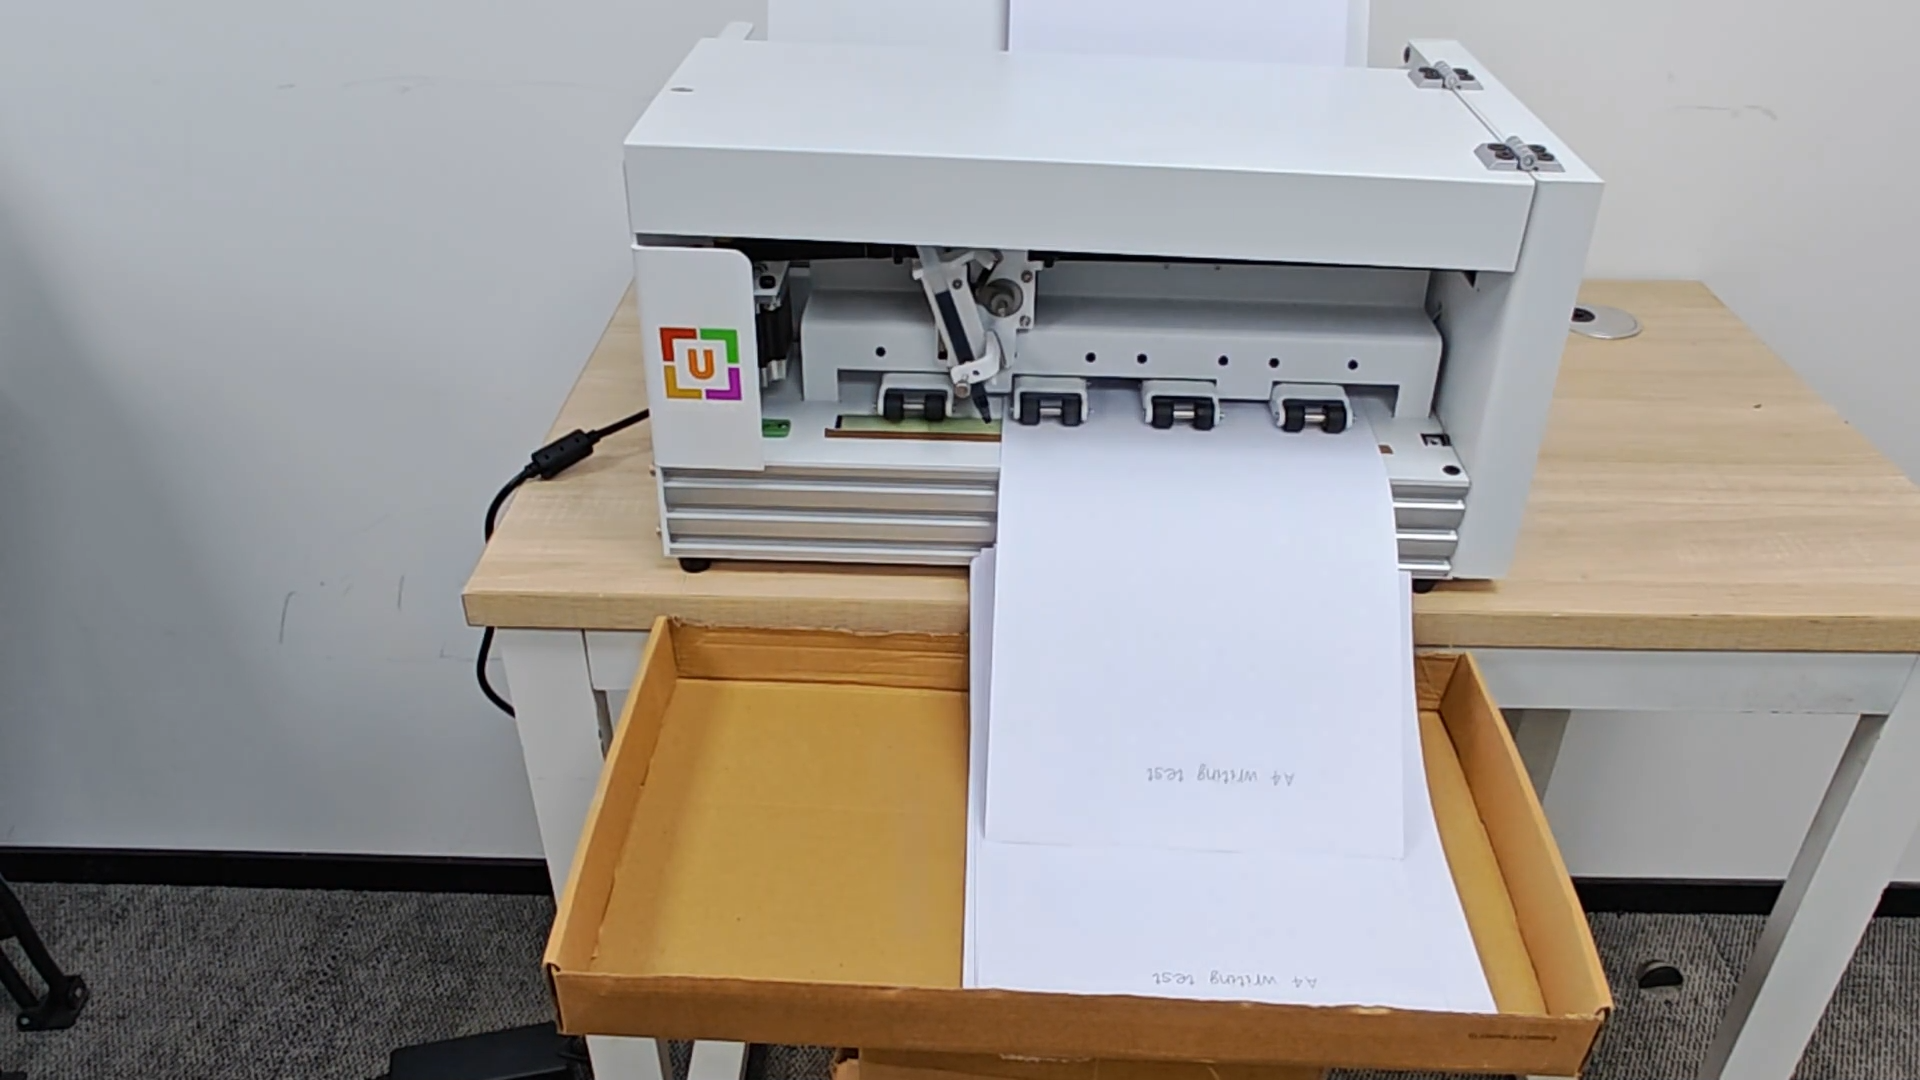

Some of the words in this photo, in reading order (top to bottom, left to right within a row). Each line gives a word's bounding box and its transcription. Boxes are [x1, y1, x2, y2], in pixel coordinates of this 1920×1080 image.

[687, 348, 715, 380] U
[1146, 766, 1184, 782] test
[1196, 763, 1258, 784] writing
[1270, 770, 1296, 786] A4
[1152, 972, 1195, 986] test
[1209, 970, 1277, 987] writing
[1292, 976, 1318, 989] A4
